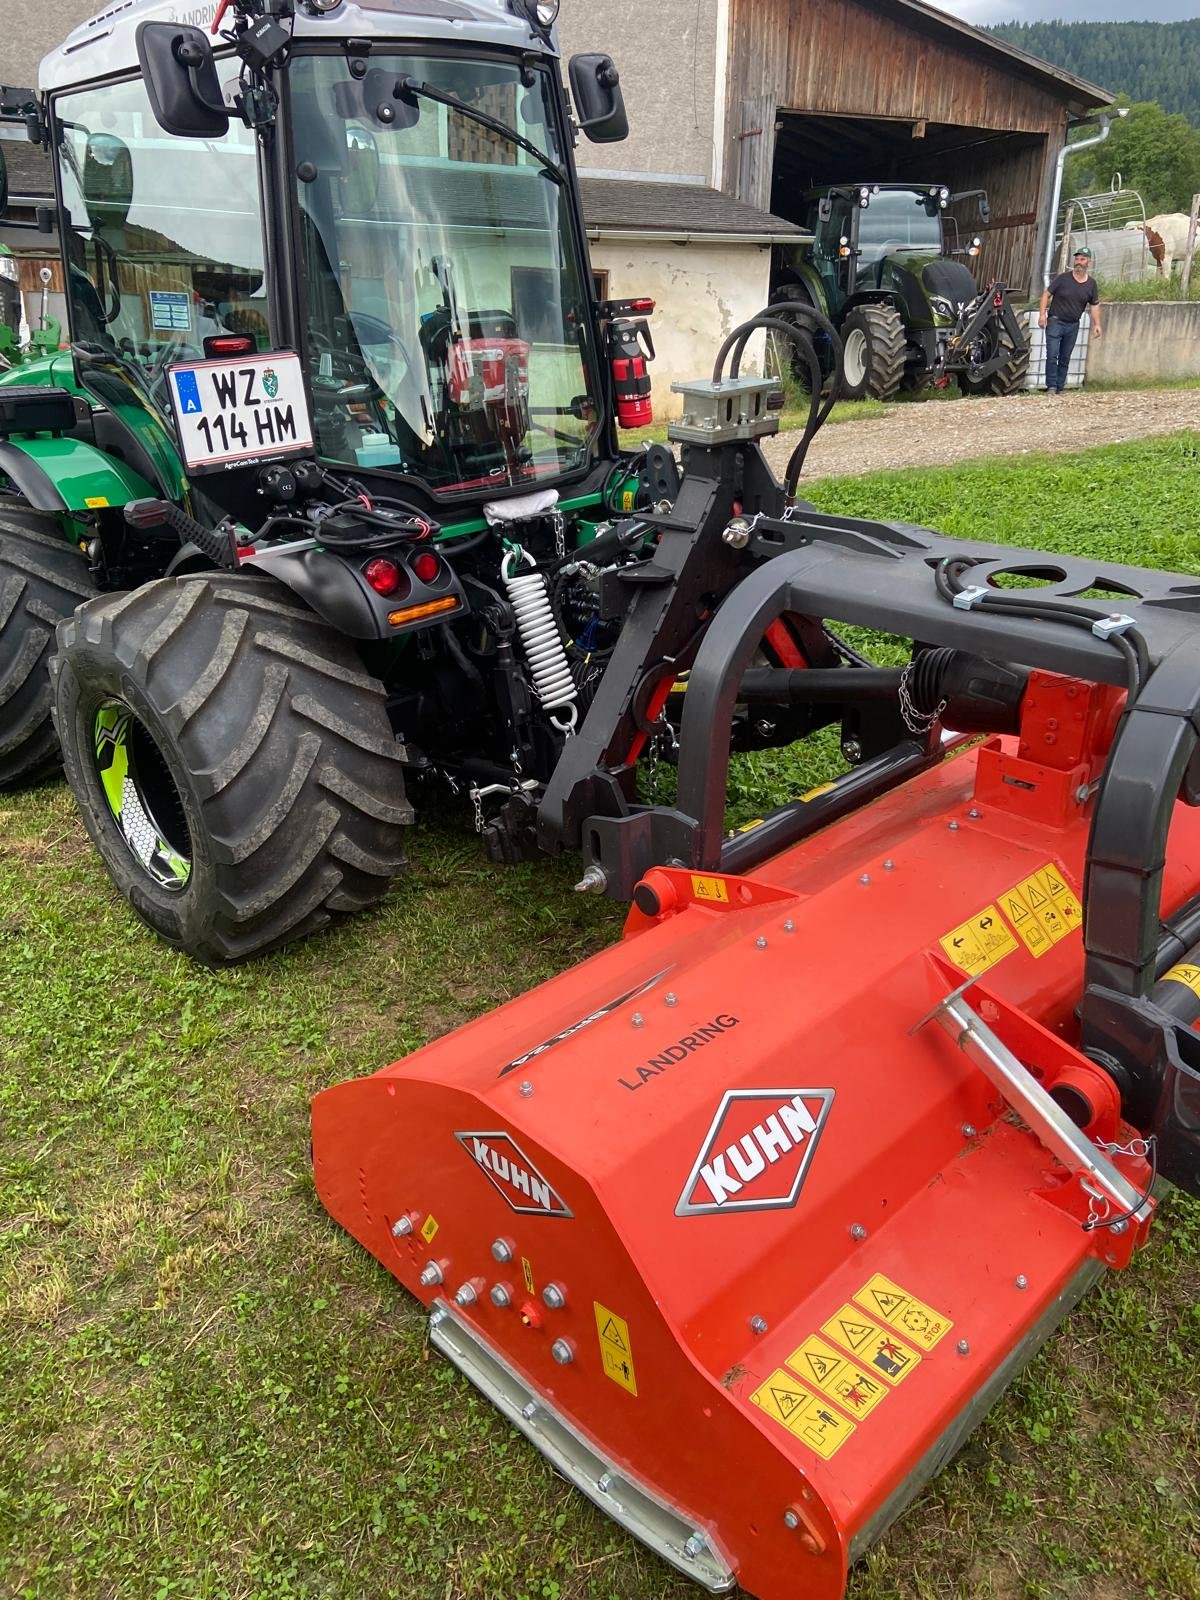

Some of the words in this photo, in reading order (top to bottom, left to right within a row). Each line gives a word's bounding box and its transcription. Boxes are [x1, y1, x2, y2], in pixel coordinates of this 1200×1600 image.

[175, 1, 231, 25] ANDRIN
[187, 399, 197, 411] A
[212, 369, 261, 410] WZ
[197, 412, 248, 453] 114
[254, 404, 297, 445] HM
[224, 458, 260, 470] AgroComTech
[617, 1013, 740, 1091] LANDRING
[699, 1095, 817, 1206] KUHN
[472, 1136, 551, 1211] KUHN
[923, 1322, 941, 1341] STOP
